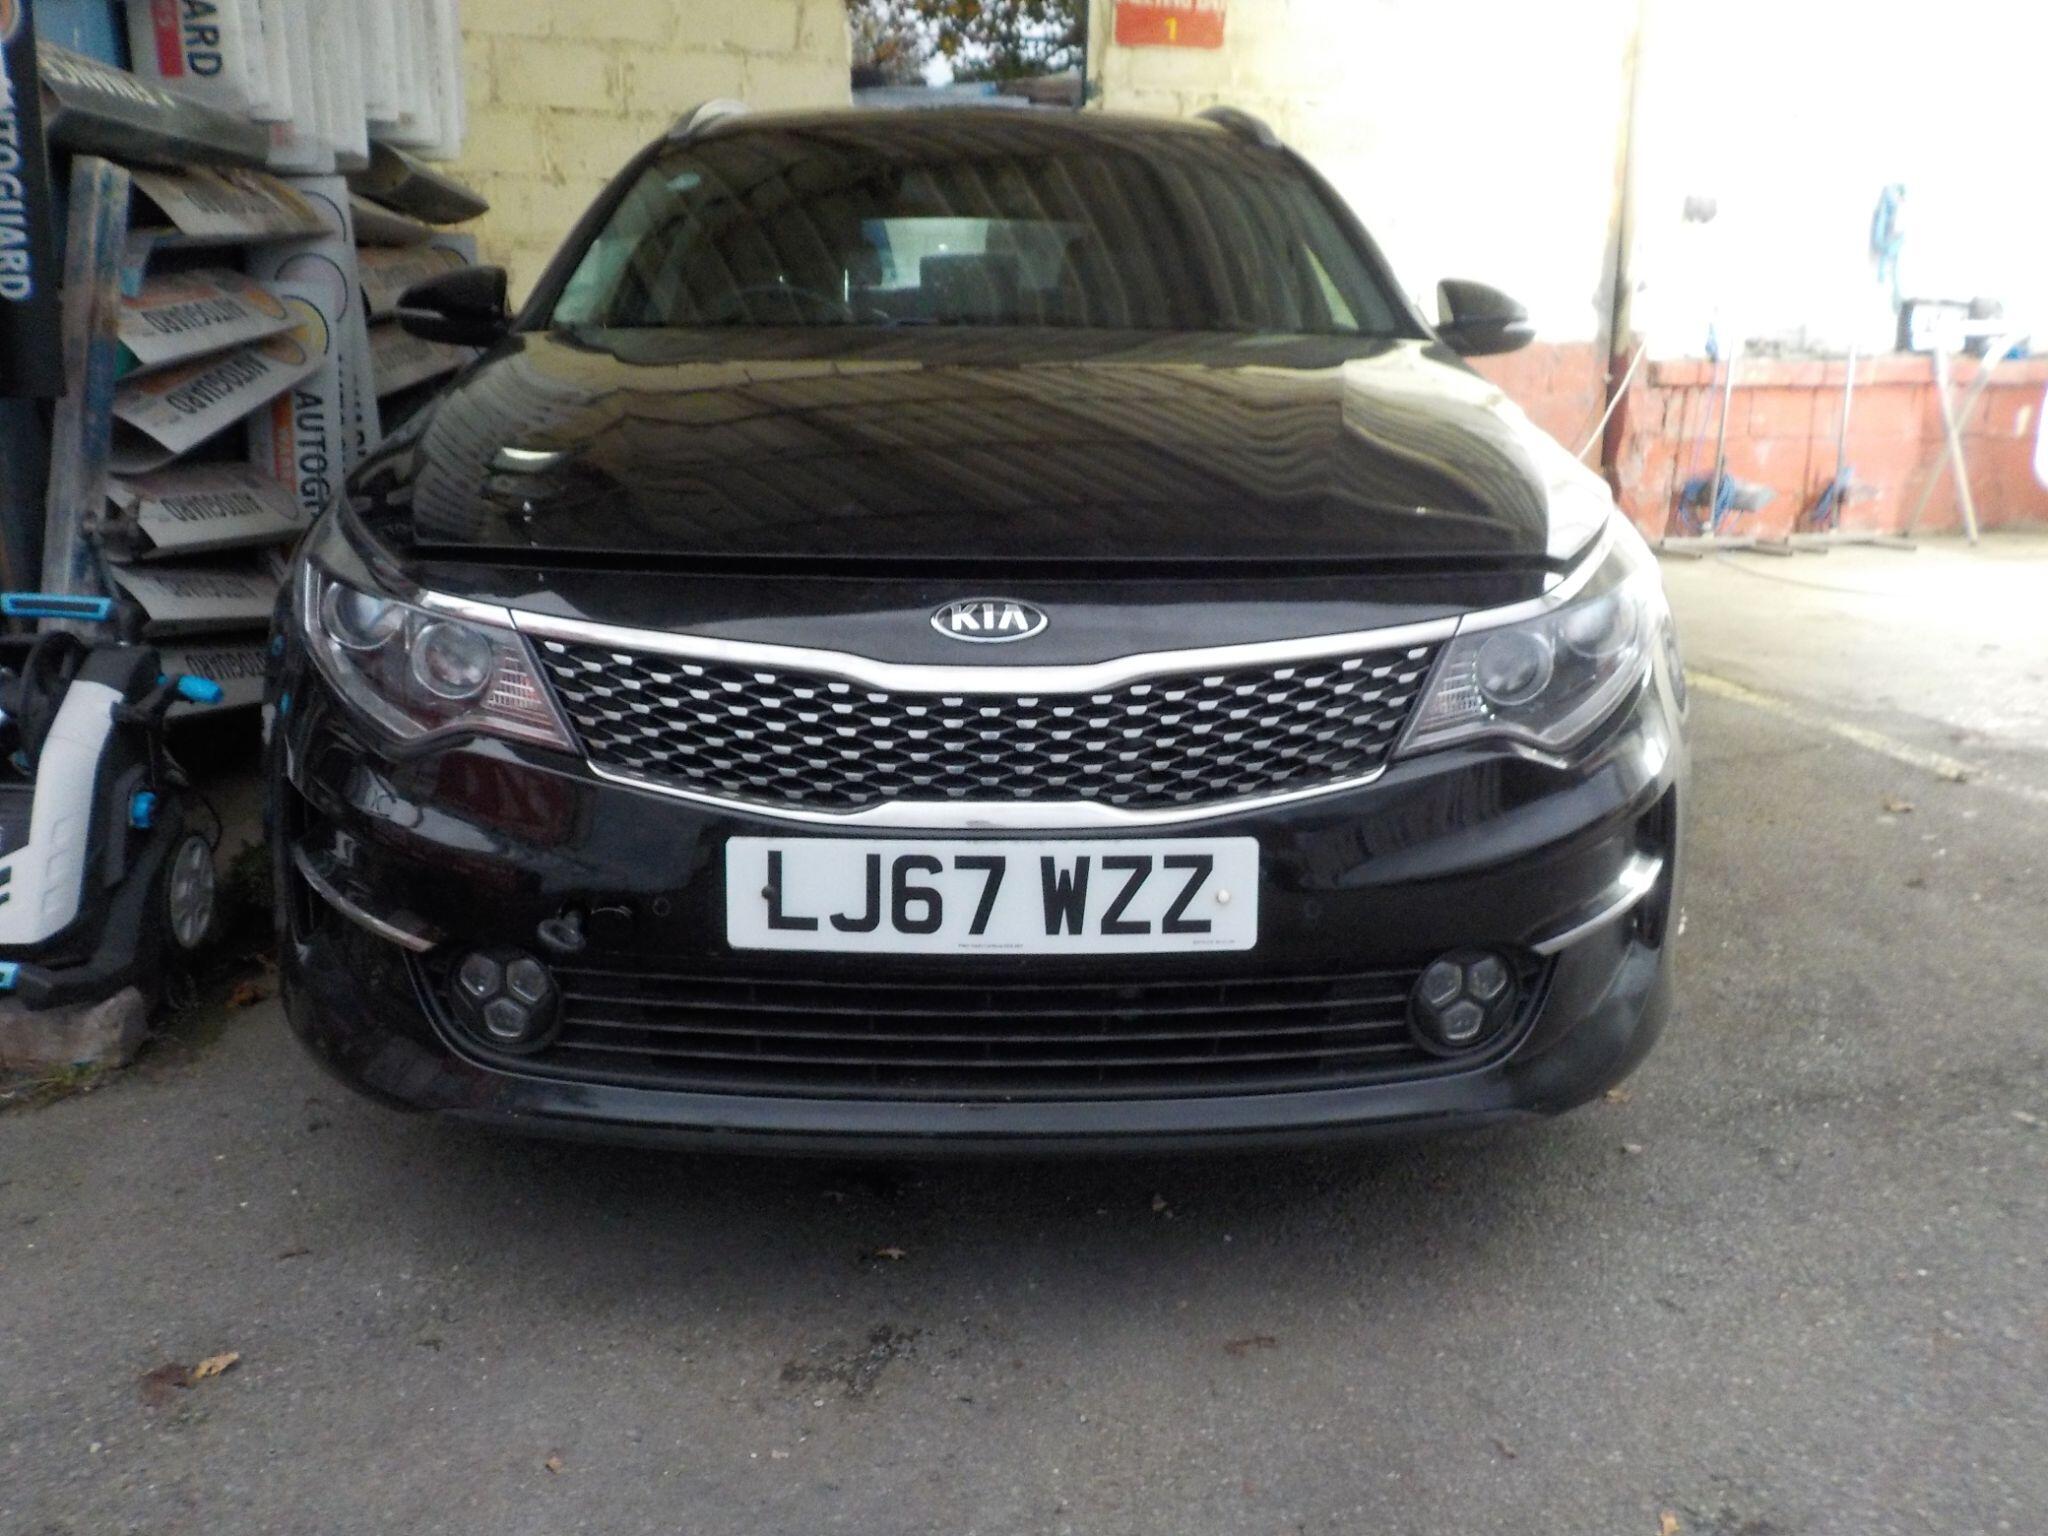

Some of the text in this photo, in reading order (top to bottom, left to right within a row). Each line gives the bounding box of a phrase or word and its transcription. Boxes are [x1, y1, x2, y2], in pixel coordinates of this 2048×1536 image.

[1164, 16, 1178, 42] 1
[950, 603, 1029, 631] KIA
[767, 850, 1213, 935] LJ67 WZZ
